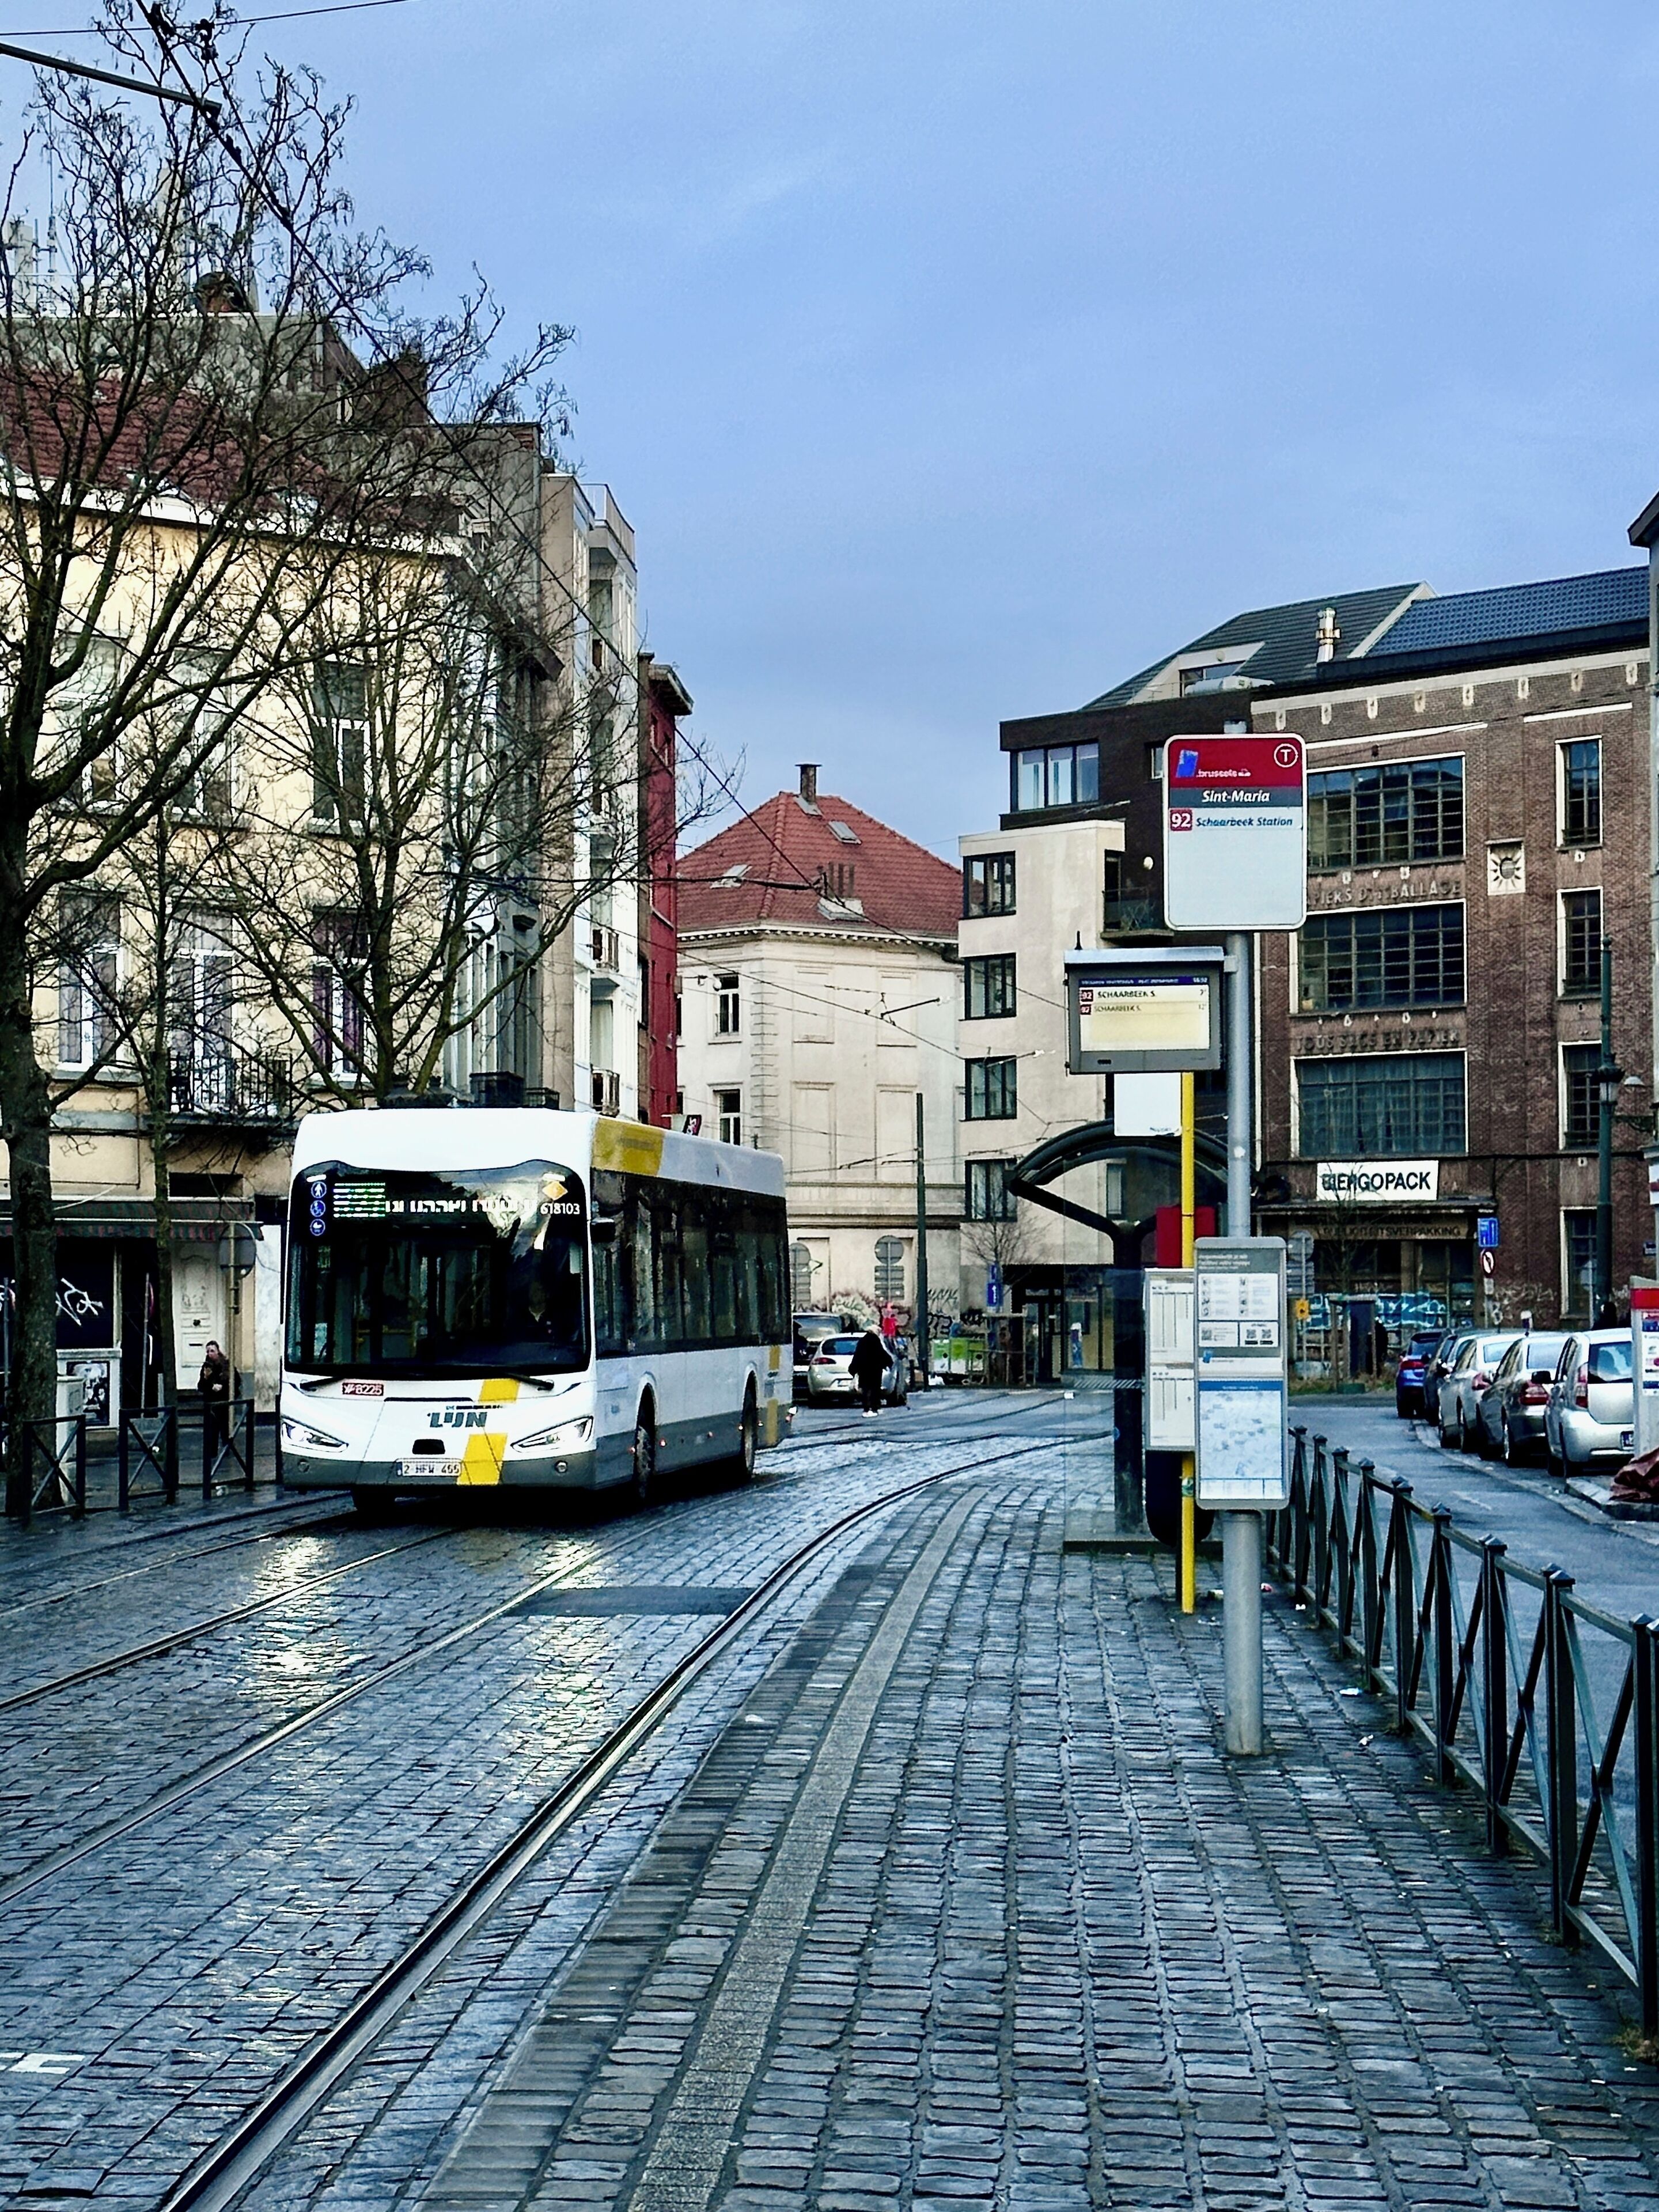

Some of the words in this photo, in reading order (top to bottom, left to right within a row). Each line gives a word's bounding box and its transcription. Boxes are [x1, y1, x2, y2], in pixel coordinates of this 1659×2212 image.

[1202, 790, 1270, 802] Sint-Maria
[1171, 812, 1191, 828] 92
[1196, 817, 1254, 827] Schaarbeek
[1256, 816, 1293, 827] Station
[1097, 990, 1149, 998] SCHAARBEEK
[540, 1202, 581, 1215] 618103
